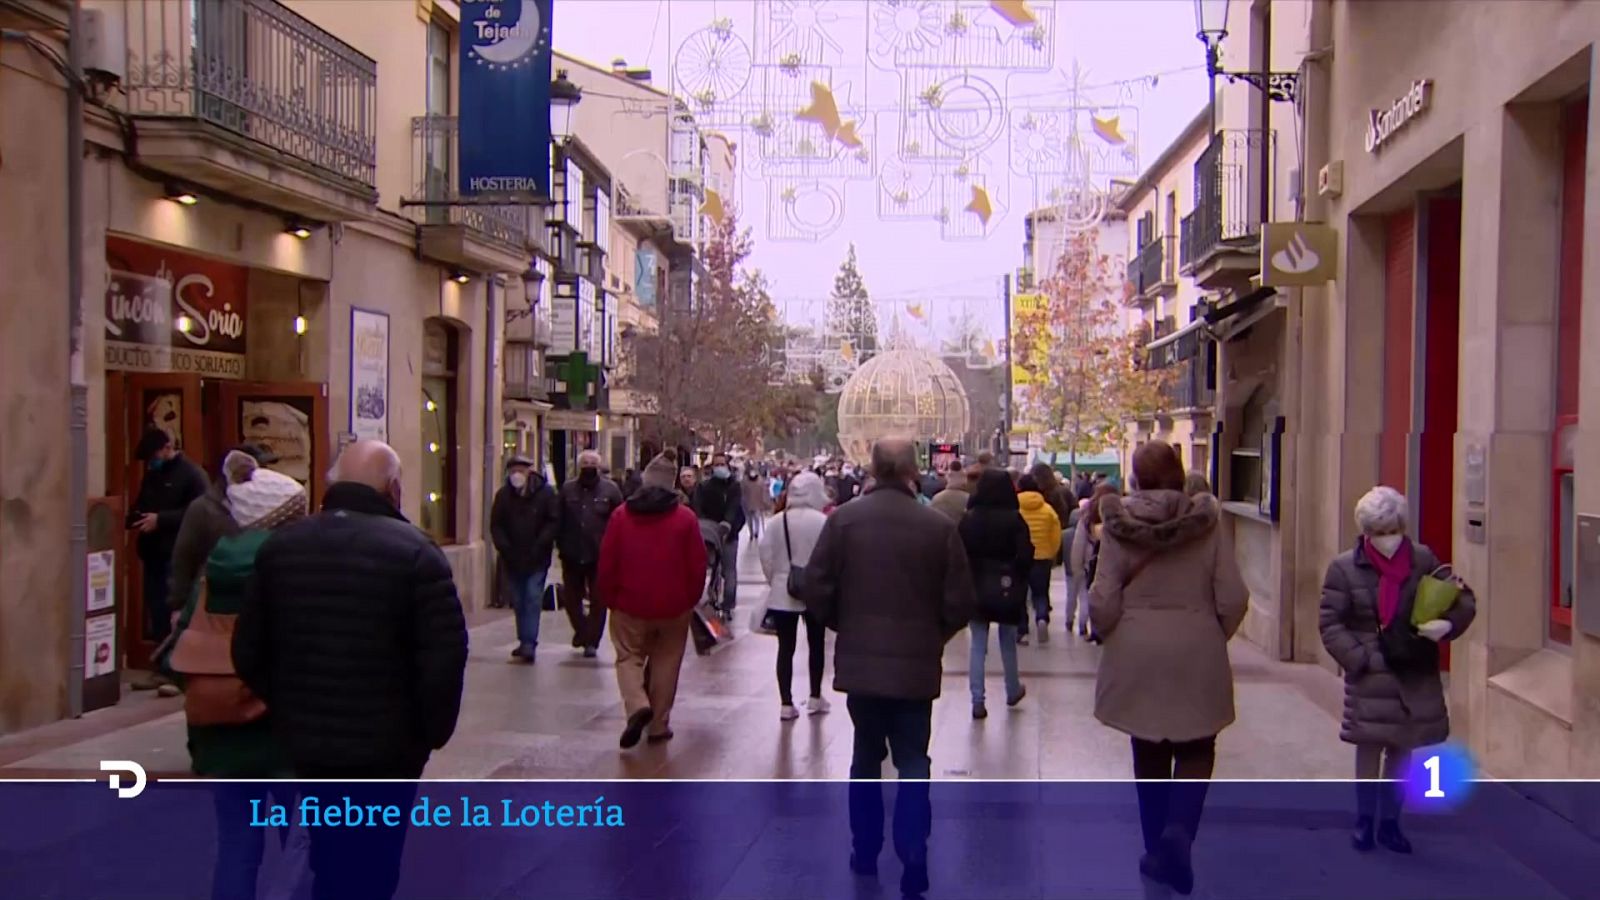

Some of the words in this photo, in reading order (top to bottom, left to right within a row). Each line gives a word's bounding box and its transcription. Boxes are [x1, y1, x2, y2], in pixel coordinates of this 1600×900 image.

[485, 5, 501, 18] de
[473, 20, 530, 43] Tejad
[1376, 80, 1426, 145] Santander
[470, 176, 537, 191] HOSTERIA
[176, 273, 243, 345] Soria
[105, 345, 151, 367] DUCTO
[194, 354, 241, 375] SORIANO
